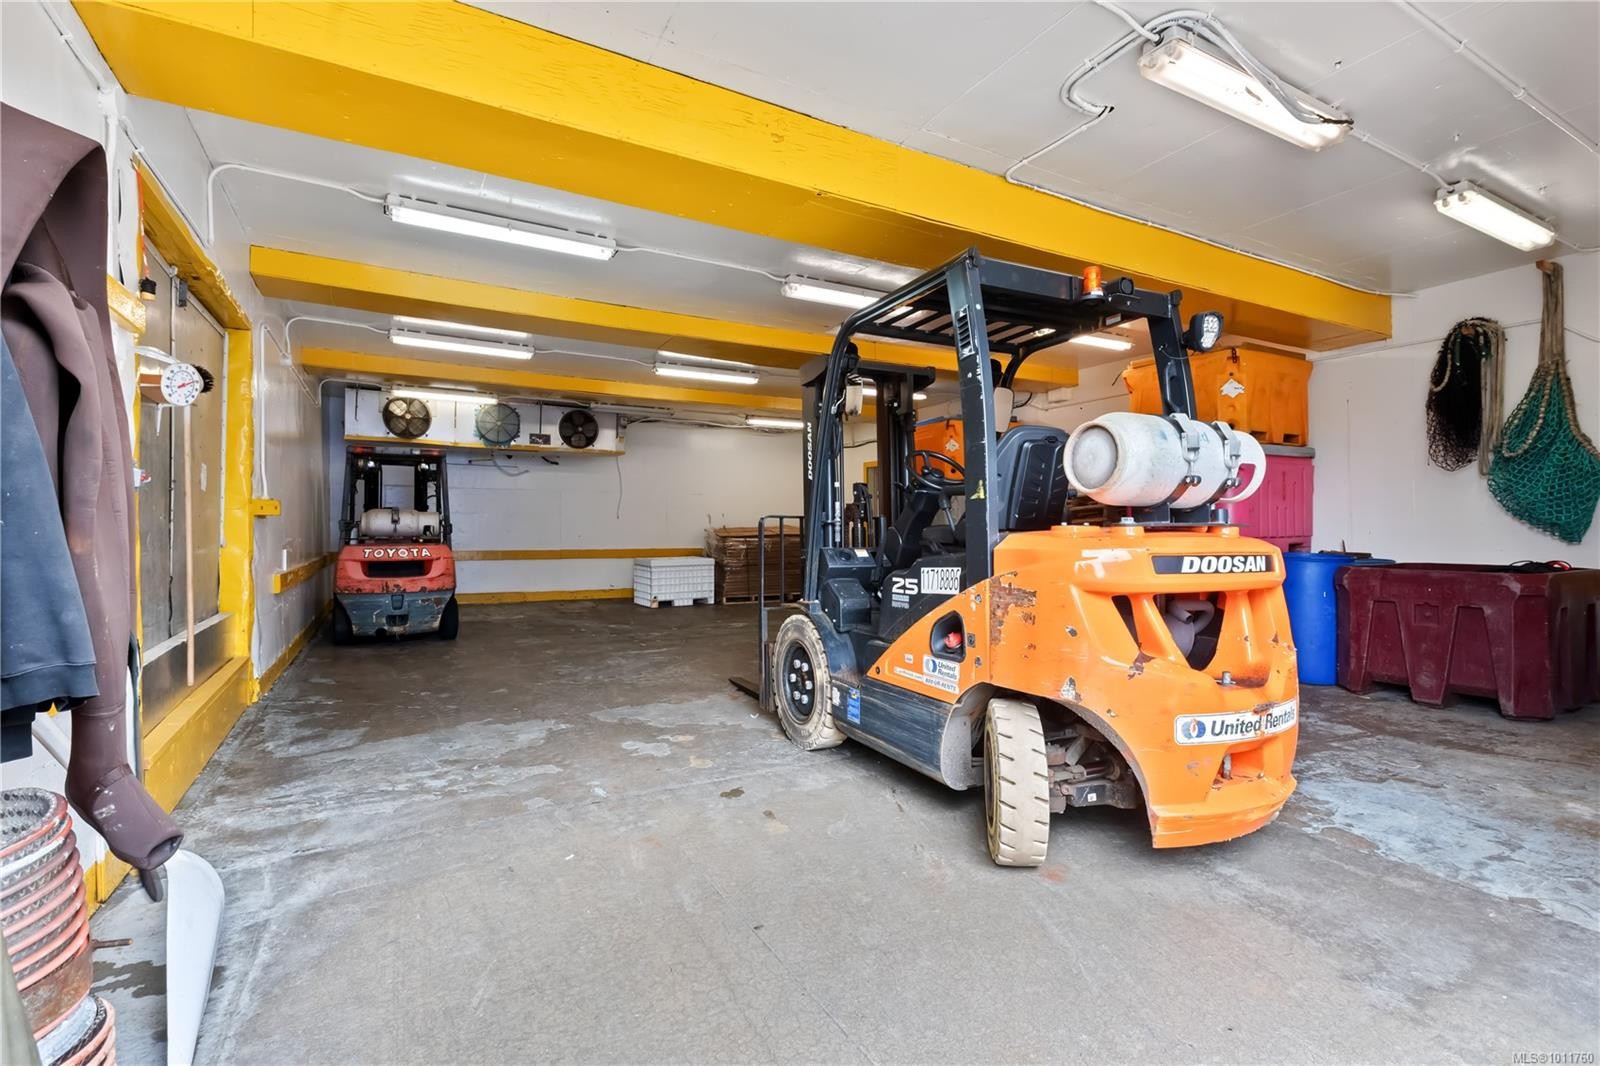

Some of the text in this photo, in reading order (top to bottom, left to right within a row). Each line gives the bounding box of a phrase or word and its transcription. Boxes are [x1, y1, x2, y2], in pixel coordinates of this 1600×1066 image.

[363, 547, 432, 559] TOYOTA
[1181, 555, 1266, 574] DOOSAN
[891, 577, 919, 595] 25
[937, 660, 957, 673] United
[937, 668, 958, 681] Rentals
[1211, 706, 1296, 737] United Rentals
